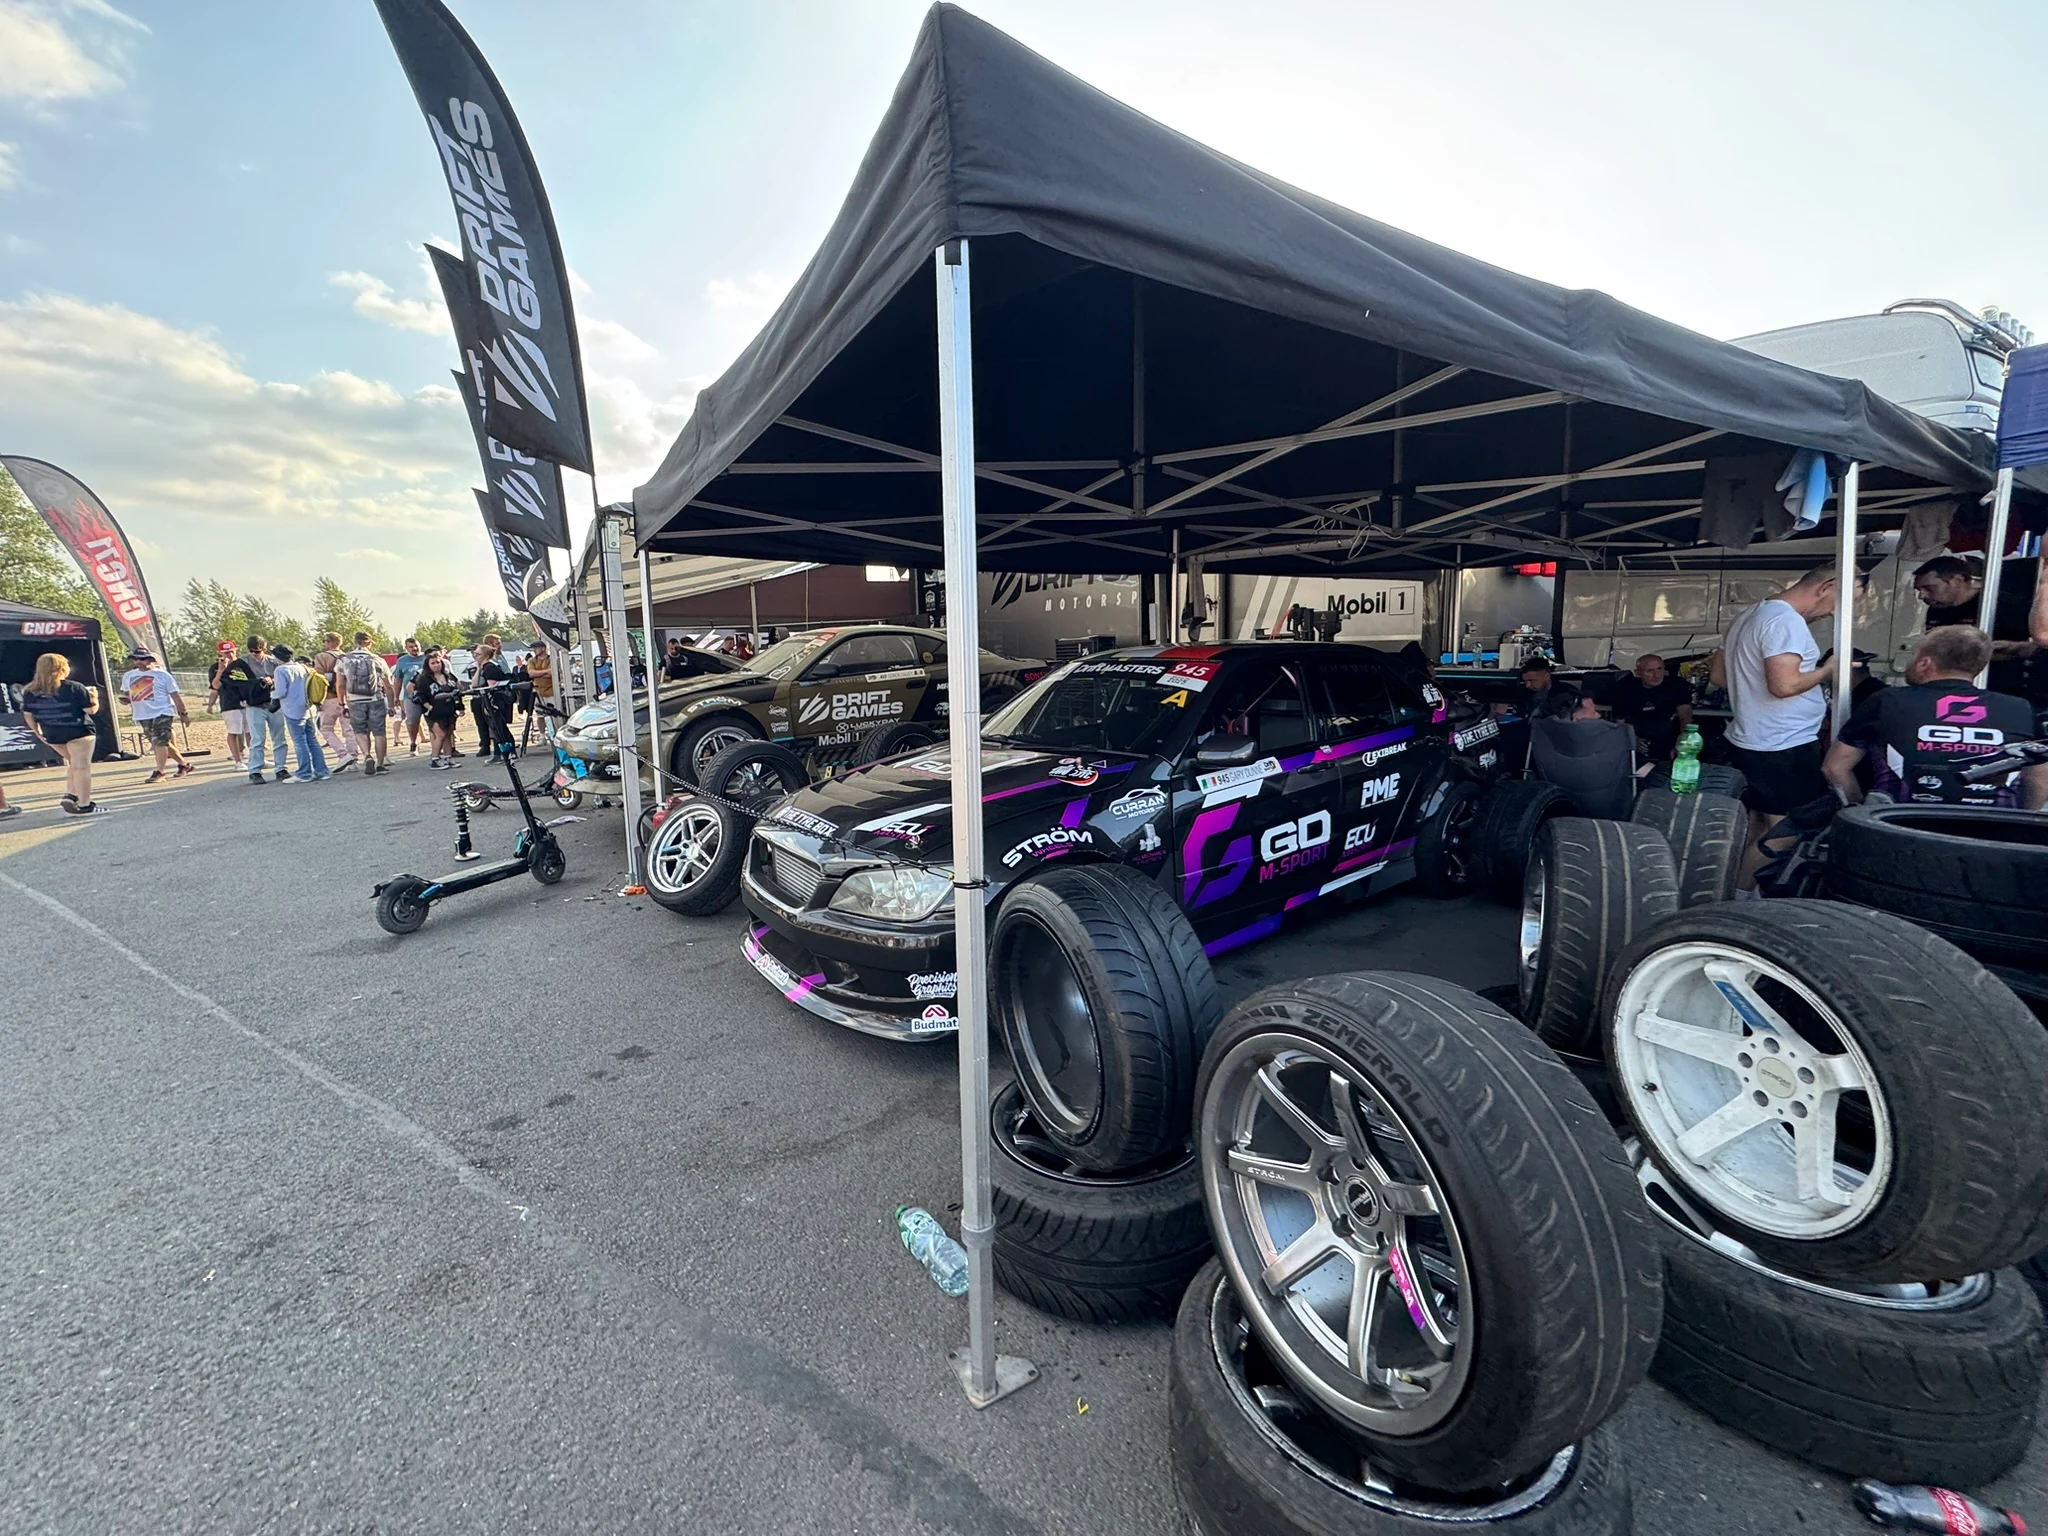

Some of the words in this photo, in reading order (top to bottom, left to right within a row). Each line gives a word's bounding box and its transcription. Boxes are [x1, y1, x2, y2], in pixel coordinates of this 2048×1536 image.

[428, 113, 511, 317] DRIFT
[449, 97, 542, 330] GAMES
[489, 527, 512, 576] DRIFT
[1328, 591, 1387, 615] Mobil
[1024, 671, 1048, 681] SONA
[1172, 663, 1210, 677] 945
[832, 690, 891, 708] DRIFT
[1160, 689, 1189, 708] A
[832, 702, 903, 720] GAMES
[819, 733, 851, 747] Mobil
[1918, 724, 2004, 746] GD
[1217, 773, 1230, 786] 945
[1360, 772, 1401, 808] PME
[1112, 795, 1165, 816] CURRAN
[1128, 807, 1156, 818] MOTORS
[796, 811, 817, 829] TYRE
[814, 820, 837, 838] BOX
[1260, 809, 1331, 863] GD
[1002, 827, 1094, 868] STRÖM
[1258, 842, 1331, 884] M-SPORT
[904, 970, 957, 986] Precision
[914, 1019, 958, 1030] Budmat
[1301, 1008, 1450, 1148] ZEMERALD
